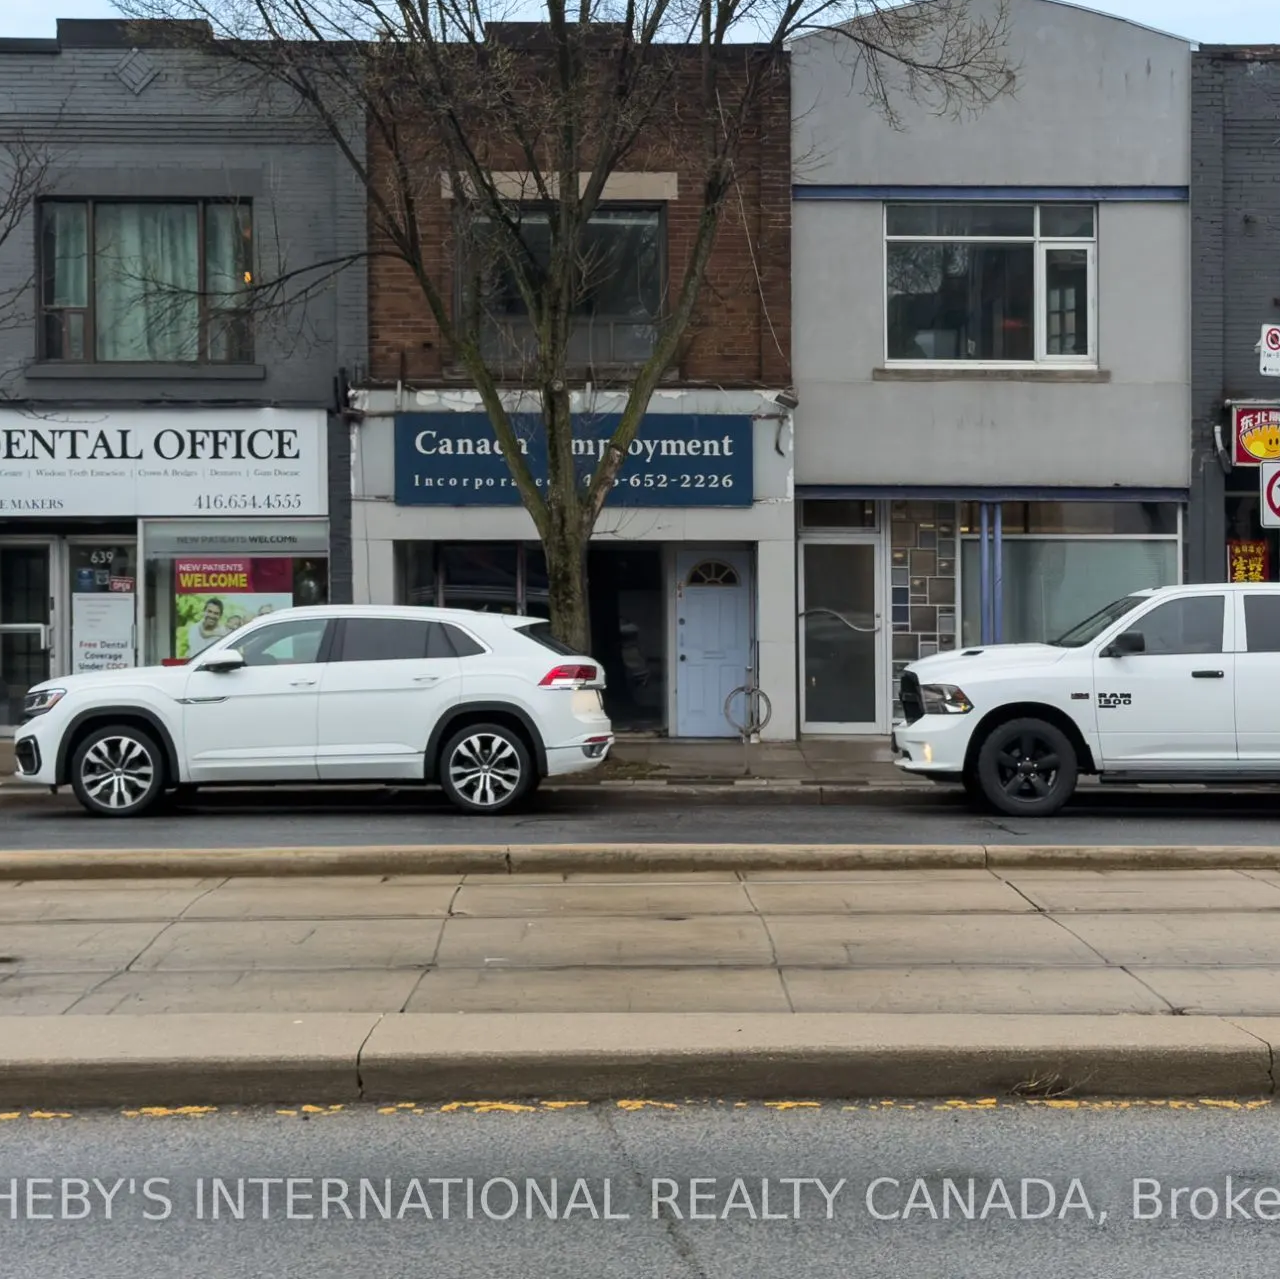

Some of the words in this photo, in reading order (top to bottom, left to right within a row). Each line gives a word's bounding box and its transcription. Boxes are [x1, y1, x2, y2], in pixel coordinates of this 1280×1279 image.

[153, 428, 300, 460] OFFICE
[414, 474, 552, 489] Incorporae
[583, 474, 734, 488] 4-652-2226
[11, 499, 64, 510] MAKERS
[195, 494, 302, 509] 416.654.4555
[248, 535, 298, 544] WELCOME
[90, 551, 115, 564] 639
[179, 563, 201, 572] NEW
[203, 563, 244, 572] PATIENTS
[180, 573, 248, 588] WELCOME
[79, 641, 97, 649] Free
[100, 640, 128, 649] Dental
[84, 651, 123, 661] Coverage
[78, 663, 104, 671] Under
